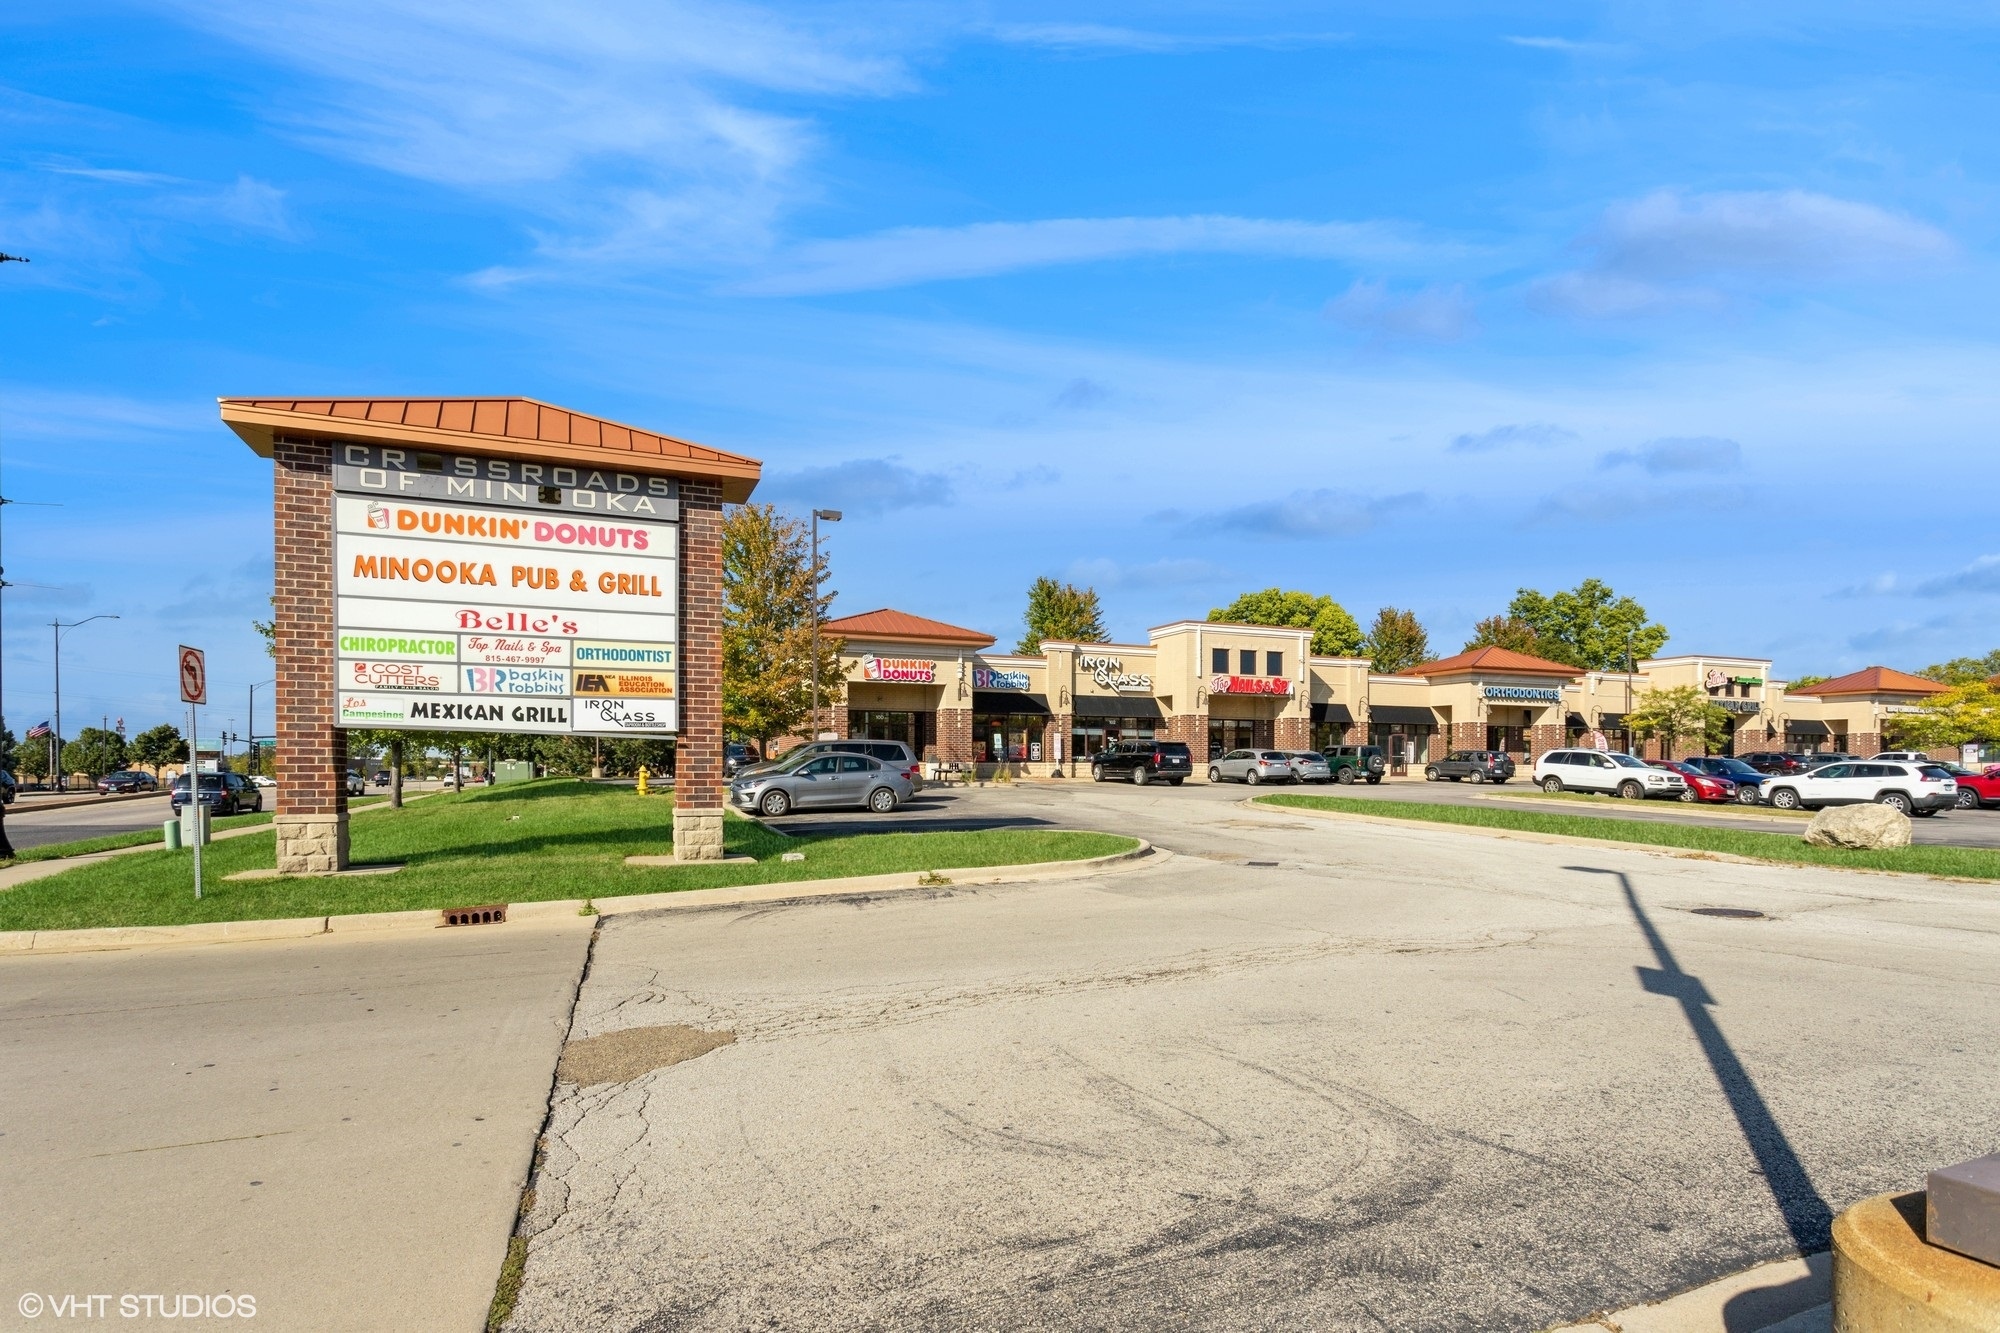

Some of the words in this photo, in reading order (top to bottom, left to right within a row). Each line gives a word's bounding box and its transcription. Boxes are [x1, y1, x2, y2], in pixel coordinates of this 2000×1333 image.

[345, 445, 668, 496] CRSSROADS
[360, 468, 421, 491] OF
[397, 509, 528, 539] DUNKIN'
[534, 521, 649, 550] DONUTS
[353, 555, 497, 586] MINOOKA
[511, 566, 560, 589] PUB
[569, 570, 588, 592] &
[598, 572, 662, 597] GRILL
[455, 609, 578, 635] Belle's
[340, 636, 456, 655] CHIROPRACTOR
[468, 637, 489, 652] Top
[494, 638, 524, 652] Nails
[527, 642, 537, 652] &
[541, 641, 562, 655] Spa
[485, 655, 545, 663] 815-467-9997
[576, 647, 671, 663] ORTHODONTIST
[372, 664, 423, 675] COST
[883, 659, 933, 669] DUNKIN'
[355, 674, 440, 686] CUTTERS
[466, 667, 507, 692] BR
[508, 669, 564, 682] baskin
[883, 670, 931, 680] DONUTS
[996, 671, 1028, 680] baskin
[508, 682, 564, 694] robbins
[575, 674, 610, 692] IEA
[996, 681, 1028, 689] robbins
[1485, 687, 1560, 699] ORTHODONTICS
[343, 697, 367, 709] Los
[343, 709, 404, 719] Campesinos
[411, 702, 504, 721] MEXICAN
[512, 706, 567, 723] GRILL
